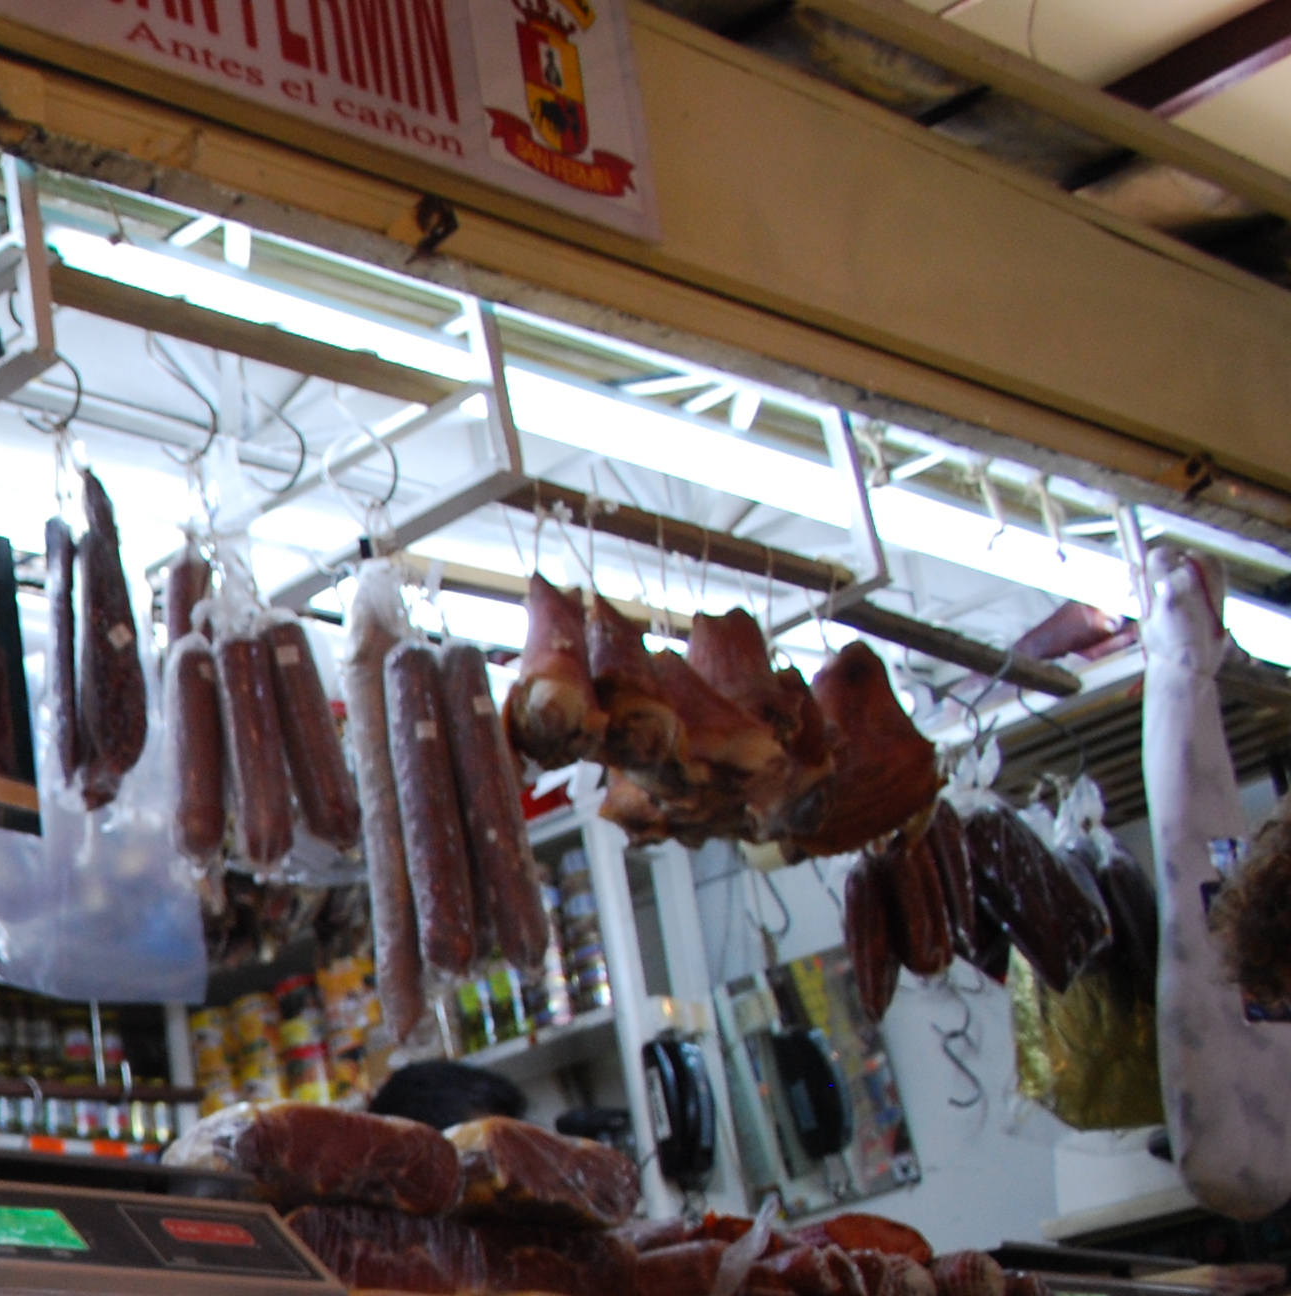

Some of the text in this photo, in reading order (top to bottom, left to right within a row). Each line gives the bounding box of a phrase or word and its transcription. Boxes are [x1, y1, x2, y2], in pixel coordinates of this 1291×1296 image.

[125, 19, 266, 88] Antes
[281, 72, 318, 108] el
[333, 91, 466, 158] cañon
